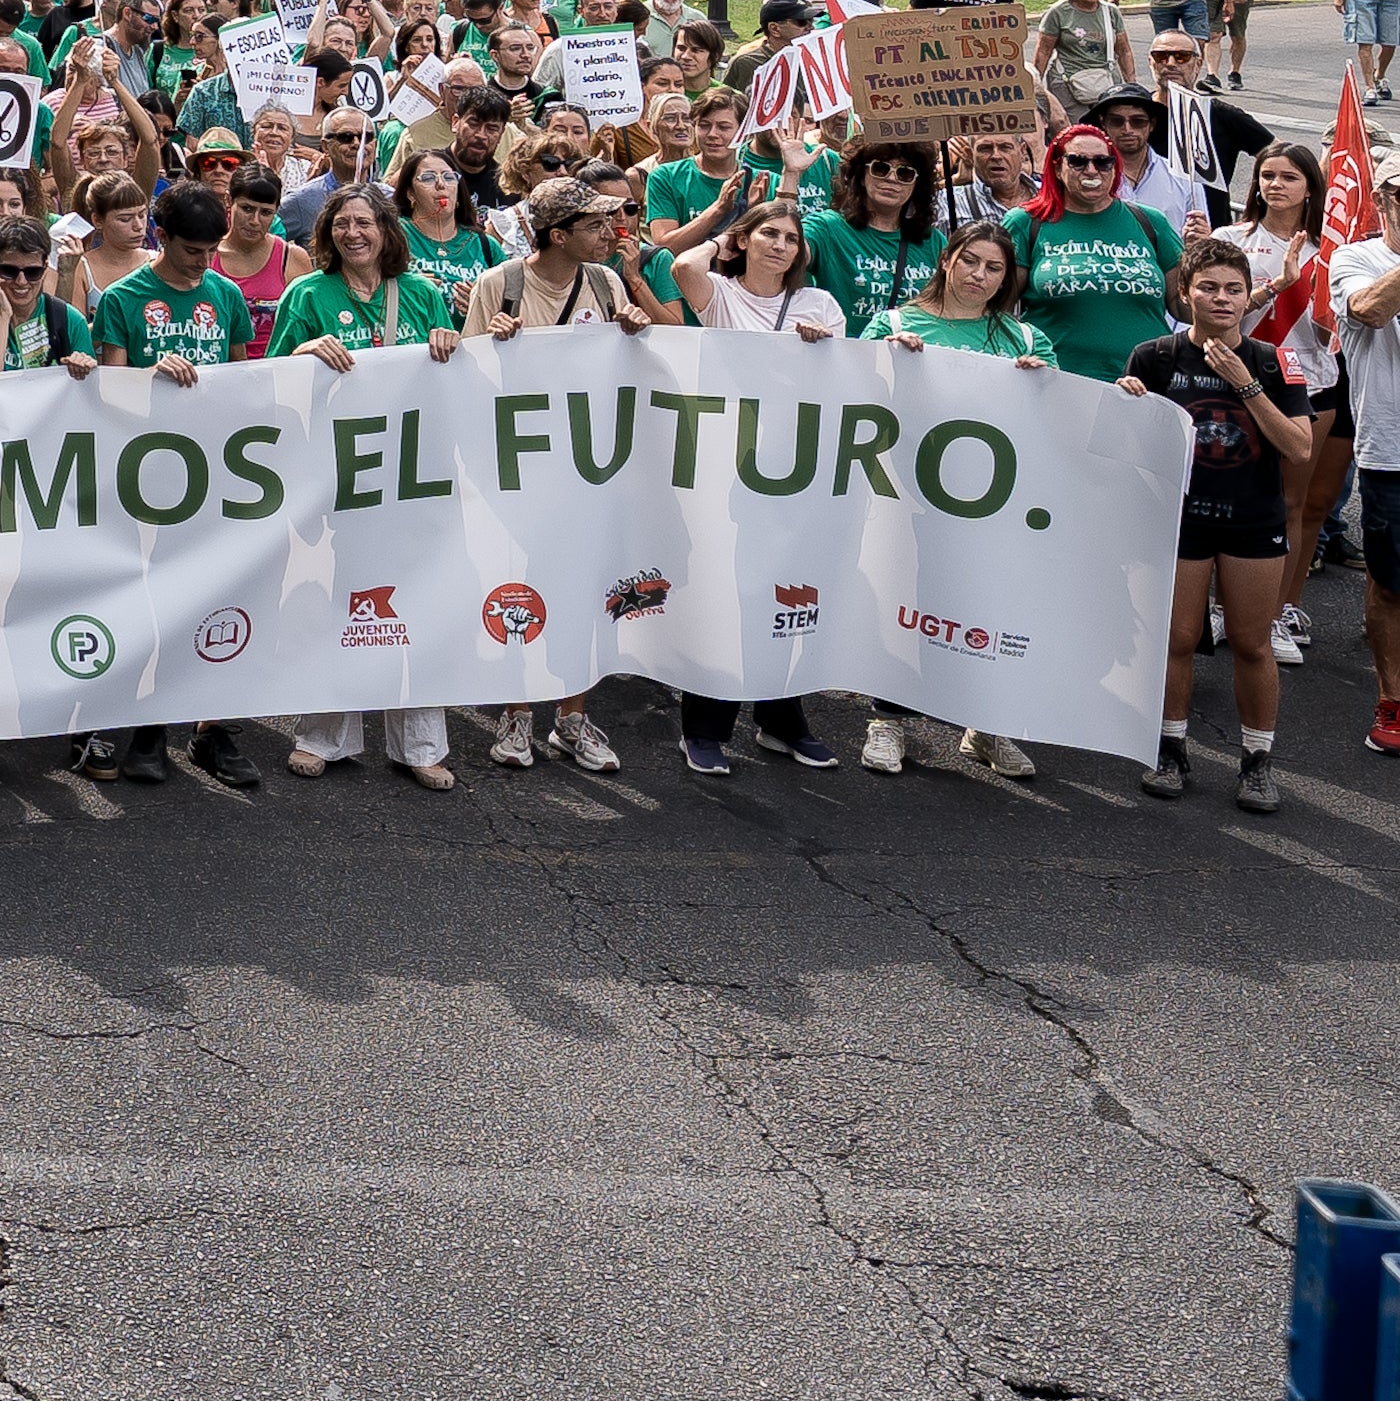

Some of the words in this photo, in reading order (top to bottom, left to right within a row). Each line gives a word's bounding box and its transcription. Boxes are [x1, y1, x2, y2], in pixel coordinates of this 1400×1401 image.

[856, 27, 875, 40] La
[931, 22, 958, 32] tiene
[237, 26, 282, 53] ESCUELAS
[566, 38, 616, 51] Maestros
[617, 37, 629, 46] x:
[583, 52, 628, 68] plantilla,
[263, 71, 295, 84] CLASE
[297, 75, 310, 84] ES
[581, 72, 623, 84] salario,
[931, 64, 1017, 83] EDUCATIVO
[248, 83, 264, 94] UN
[265, 84, 307, 97] HORNO!
[590, 89, 616, 100] ratio
[617, 89, 626, 100] y
[913, 84, 1025, 107] ORIENTADORA
[879, 118, 930, 137] DUE
[1057, 263, 1079, 275] DE
[333, 411, 456, 511] EL
[495, 385, 1057, 531] FUTURO.
[773, 607, 820, 630] STEM
[897, 604, 962, 643] UGT
[342, 622, 407, 637] JUVENTUD
[1000, 631, 1030, 643] Servicios
[68, 631, 99, 662] FP
[340, 633, 412, 648] COMUNISTA
[1000, 639, 1028, 650] Públicos
[927, 637, 950, 650] Sector
[950, 643, 958, 651] de
[958, 644, 998, 662] Enseñanza
[1000, 647, 1025, 659] Madrid
